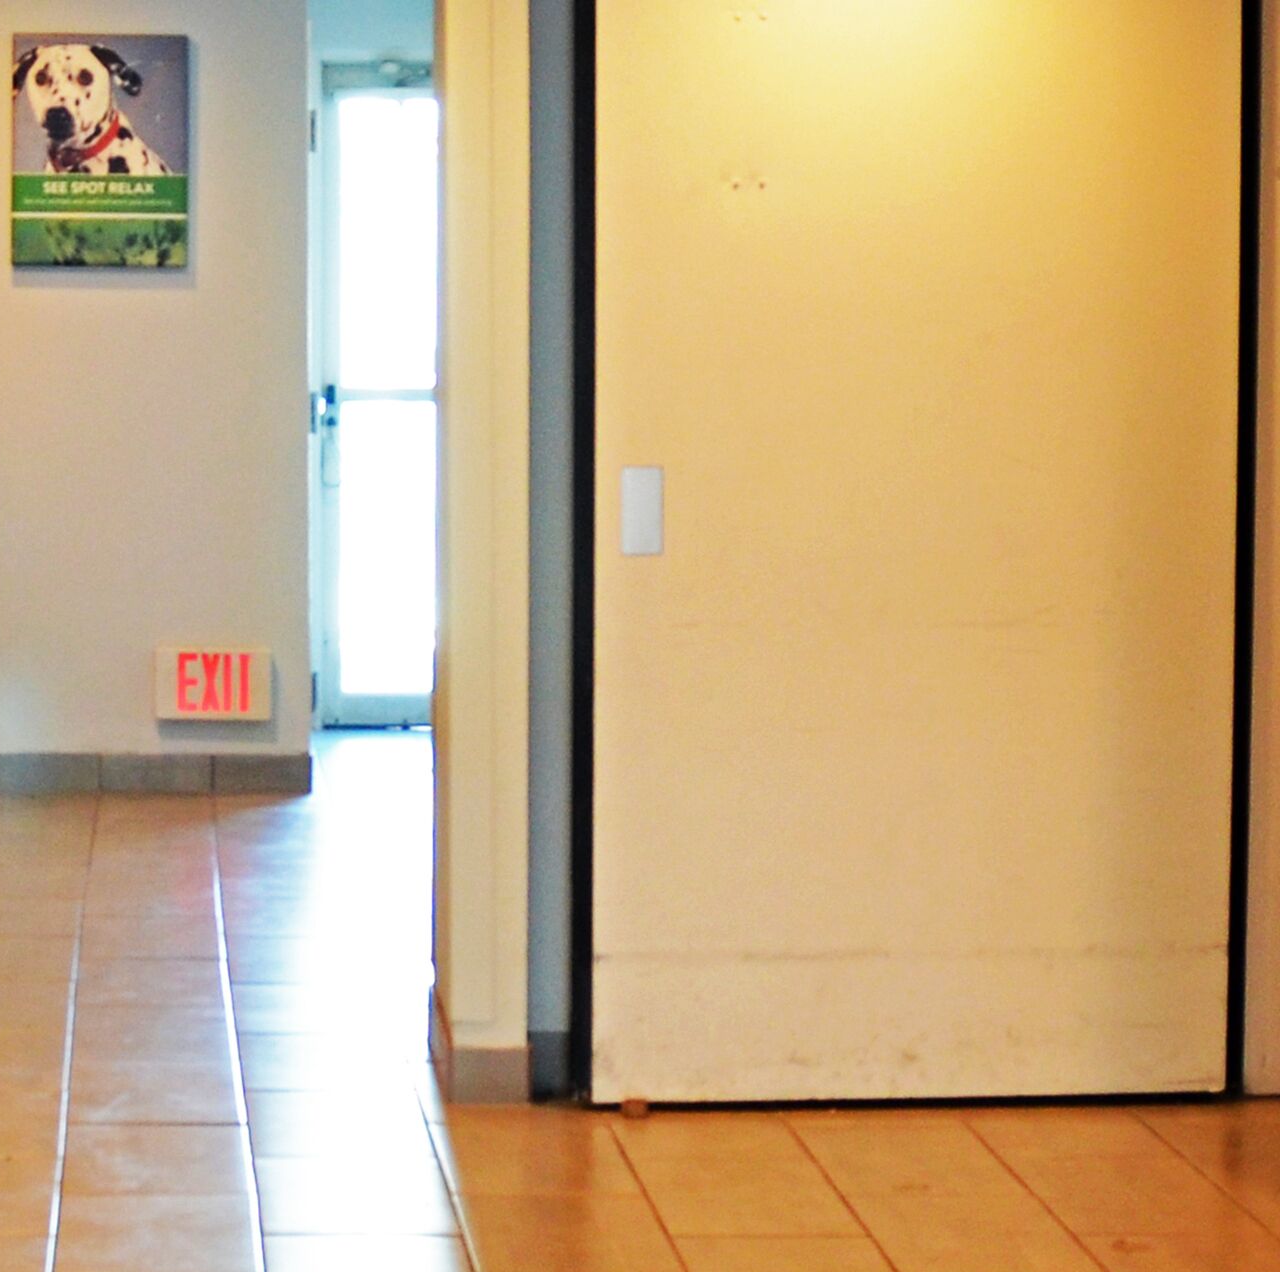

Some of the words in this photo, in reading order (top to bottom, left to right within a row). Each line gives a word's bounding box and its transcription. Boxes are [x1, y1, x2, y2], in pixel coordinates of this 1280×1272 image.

[42, 180, 68, 195] SEE
[70, 180, 107, 195] SPOT
[108, 181, 156, 196] RELAX
[176, 652, 252, 713] EXIT
